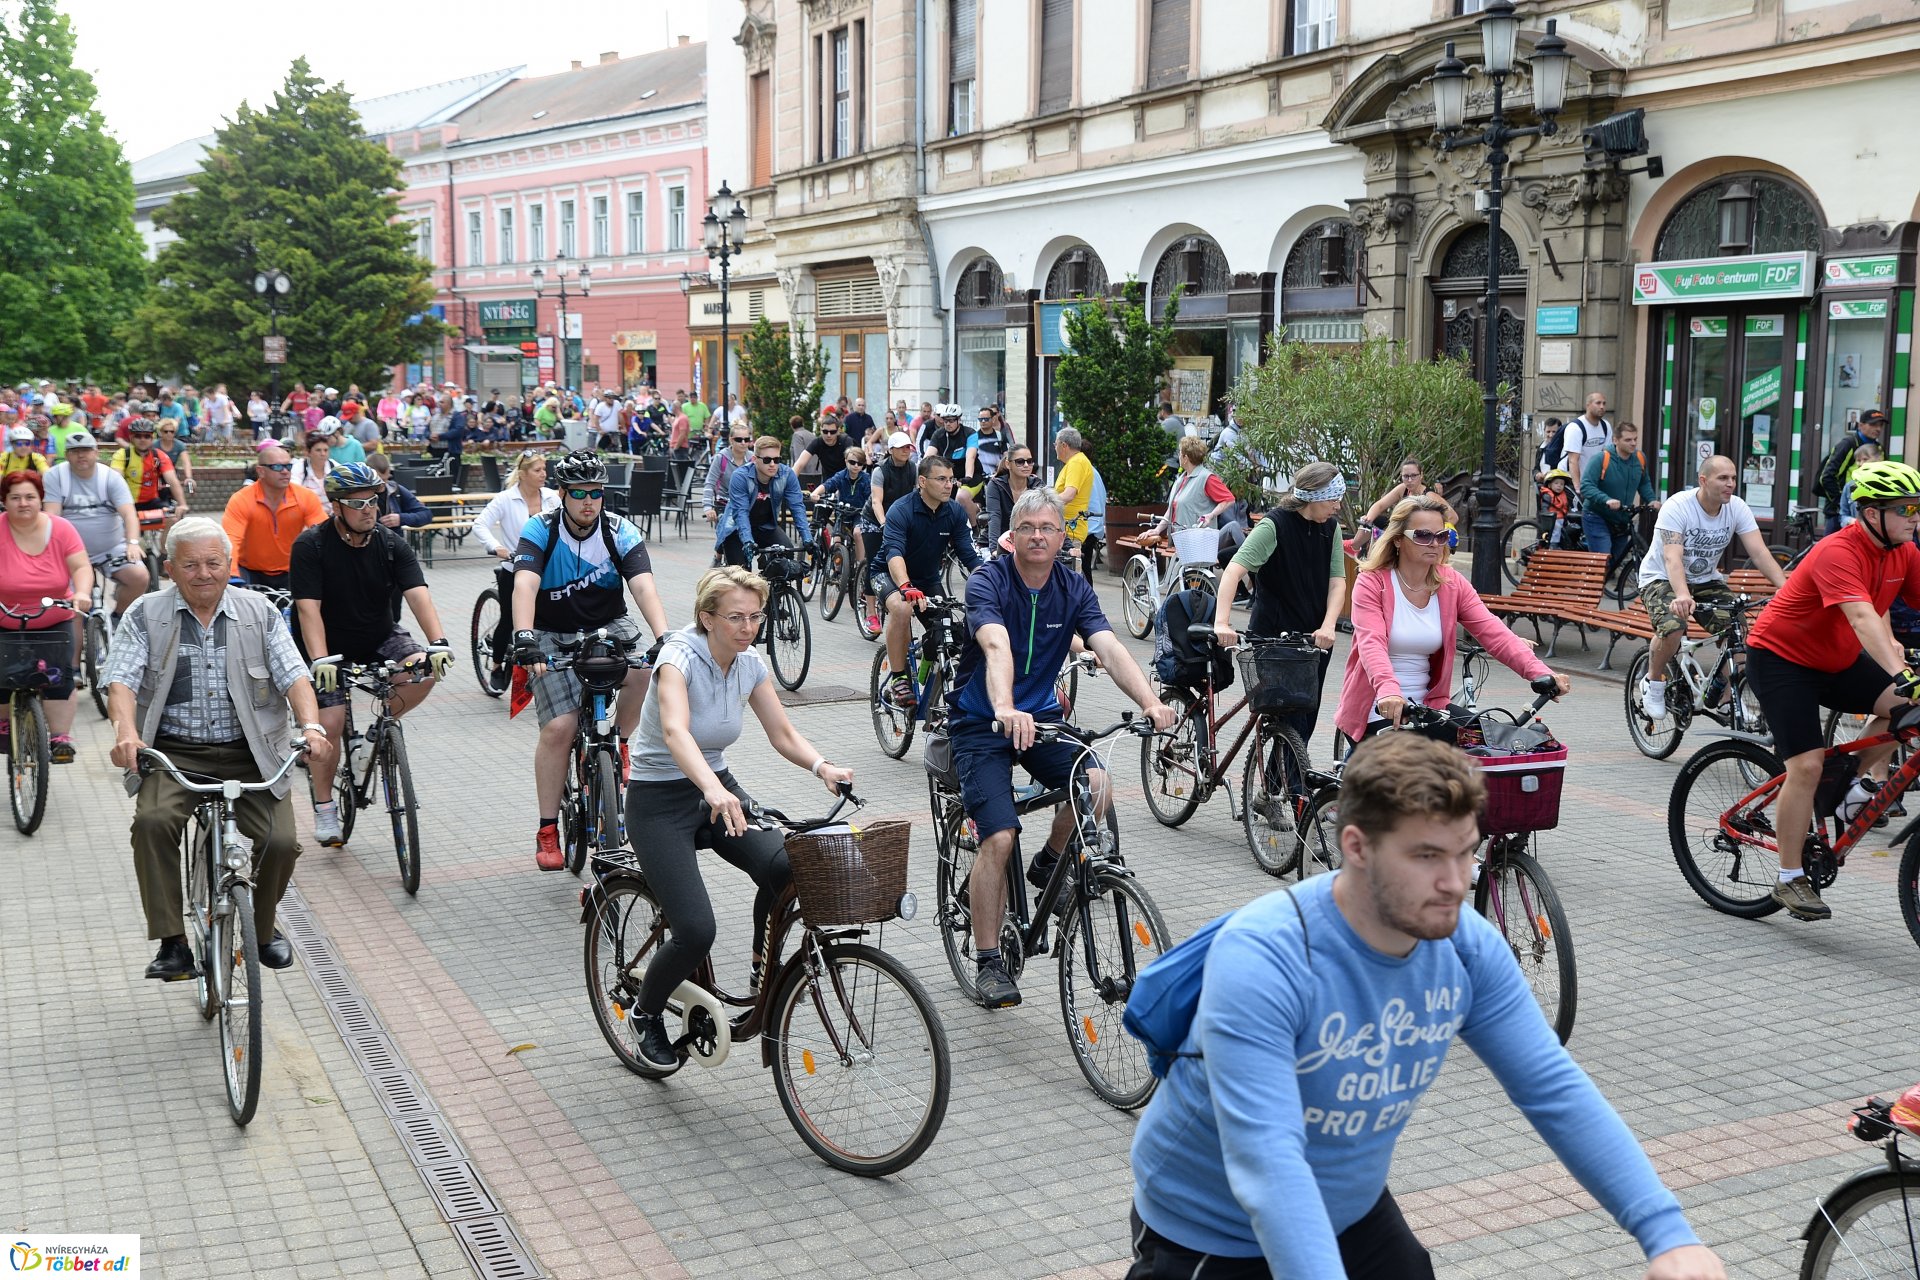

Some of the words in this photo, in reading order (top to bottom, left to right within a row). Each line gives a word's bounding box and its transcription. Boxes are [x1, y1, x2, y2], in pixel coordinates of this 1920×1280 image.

[1765, 265, 1797, 283] FDF
[1873, 265, 1892, 275] FDF
[1675, 274, 1692, 290] Fuji
[1692, 272, 1715, 287] Foto
[1716, 271, 1758, 285] Centrum
[484, 301, 530, 320] NYÍRSÉG
[1869, 303, 1884, 312] FDF
[1756, 321, 1772, 329] FDF
[1296, 1012, 1376, 1075] Jet
[1336, 1057, 1438, 1101] GOALIE
[1304, 1107, 1367, 1136] PRO
